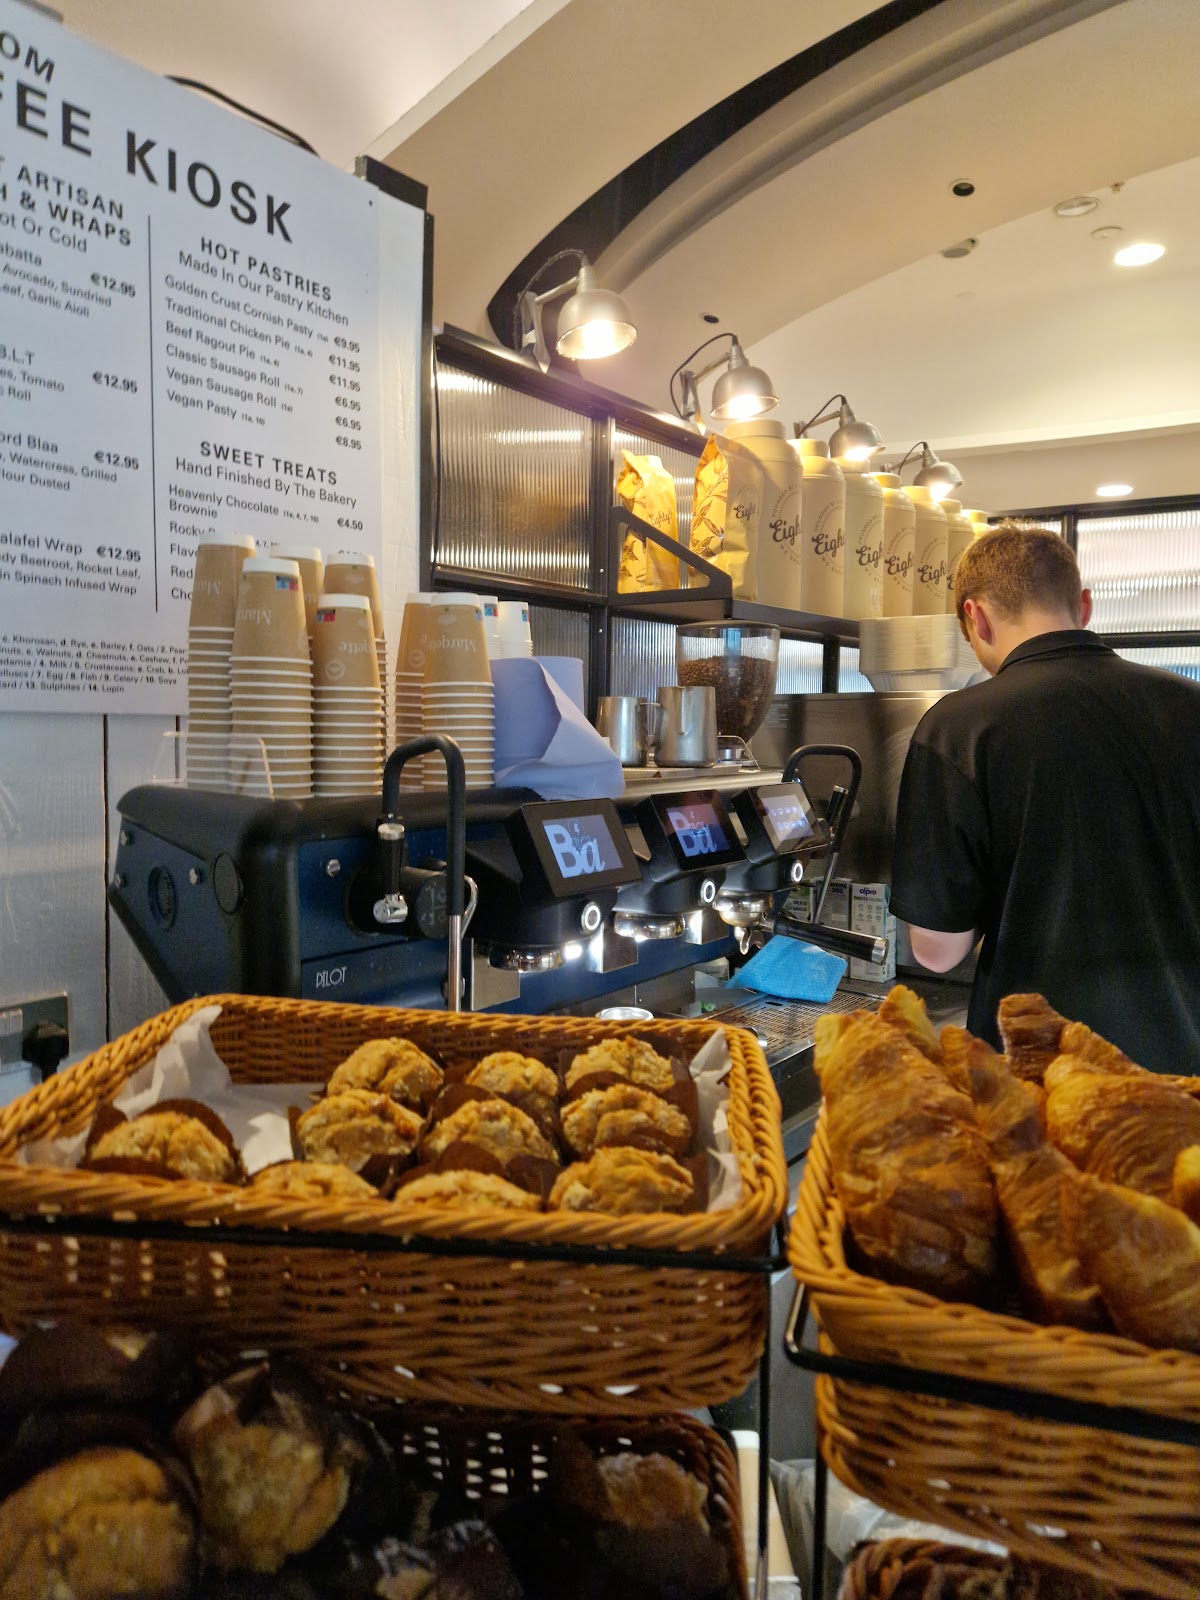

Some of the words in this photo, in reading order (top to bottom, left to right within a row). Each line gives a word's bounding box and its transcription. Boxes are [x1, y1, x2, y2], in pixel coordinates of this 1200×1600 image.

[0, 72, 92, 157] EE
[126, 128, 293, 243] KIOSK
[17, 164, 124, 220] ARTISAN
[20, 189, 36, 213] &
[48, 200, 131, 247] WRAPS
[22, 216, 43, 237] Or
[49, 226, 87, 253] Cold
[200, 236, 240, 267] HOT
[247, 256, 332, 302] PASTRIES
[0, 283, 24, 299] eaf,
[61, 280, 112, 308] Sundried
[90, 271, 136, 298] €12.95
[178, 250, 218, 278] Made
[222, 267, 234, 285] In
[238, 273, 263, 295] Our
[266, 283, 303, 312] Pastry
[306, 299, 349, 327] Kitchen
[165, 274, 208, 300] Golden
[211, 290, 240, 312] Crust
[243, 302, 284, 328] Cornish
[286, 318, 314, 339] Pasty
[165, 296, 227, 329] Traditional
[230, 319, 272, 344] Chicken
[274, 335, 291, 350] Pie
[166, 320, 193, 340] Beef
[196, 330, 236, 354] Ragout
[239, 344, 256, 360] Pie
[334, 336, 360, 353] €9.95
[166, 343, 208, 367] Classic
[210, 356, 257, 382] Sausage
[260, 371, 280, 388] Roll
[328, 354, 361, 373] €11.95
[20, 370, 65, 393] Tomato
[92, 371, 138, 394] €12.95
[166, 365, 203, 387] Vegan
[206, 377, 254, 402] Sausage
[256, 391, 277, 408] Roll
[328, 374, 361, 393] €11.95
[167, 388, 204, 409] Vegan
[207, 399, 237, 420] Pasty
[335, 396, 361, 412] €6.95
[335, 416, 362, 432] €6.95
[27, 434, 58, 455] Blaa
[335, 435, 362, 451] €8.95
[94, 450, 139, 471] €12.95
[200, 440, 265, 469] SWEET
[272, 457, 337, 486] TREATS
[30, 472, 70, 491] Dusted
[81, 465, 117, 484] Grilled
[176, 456, 212, 477] Hand
[216, 465, 271, 490] Finished
[275, 479, 290, 496] By
[294, 482, 316, 499] The
[319, 488, 357, 509] Bakery
[169, 483, 223, 507] Heavenly
[225, 494, 279, 516] Chocolate
[169, 498, 218, 519] Brownie
[337, 517, 363, 531] €4.50
[44, 536, 83, 556] Wrap
[96, 544, 142, 563] €12.95
[20, 553, 74, 572] Beetroot,
[77, 560, 113, 577] Rocket
[116, 566, 142, 580] Leaf,
[170, 565, 193, 580] Red
[15, 570, 62, 587] Spinach
[65, 577, 106, 592] Infused
[109, 580, 138, 596] Wrap
[315, 966, 348, 989] PILOT
